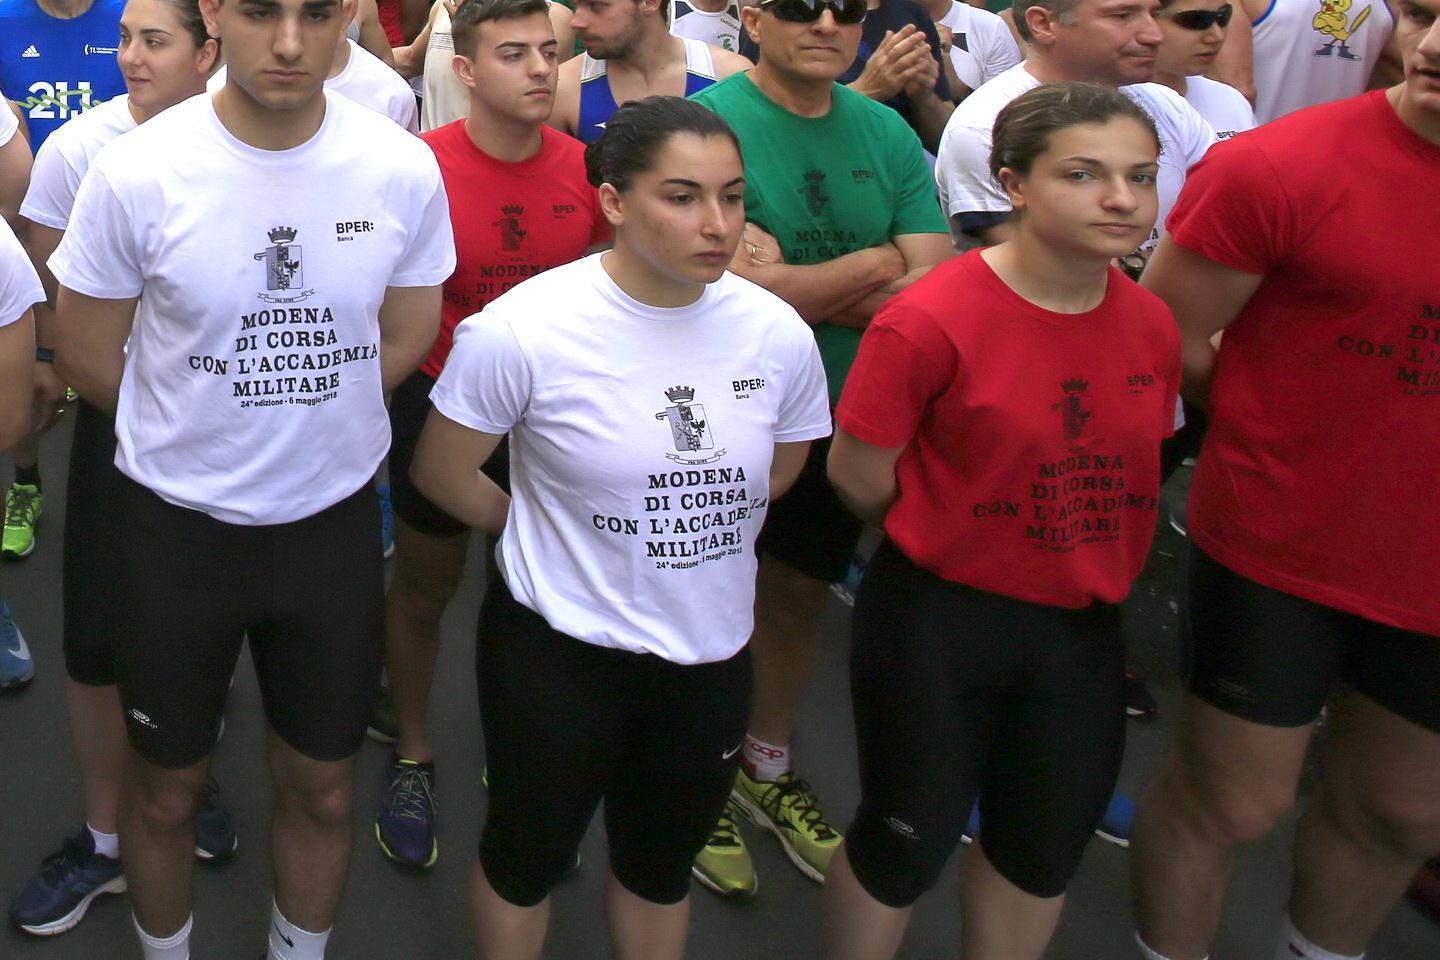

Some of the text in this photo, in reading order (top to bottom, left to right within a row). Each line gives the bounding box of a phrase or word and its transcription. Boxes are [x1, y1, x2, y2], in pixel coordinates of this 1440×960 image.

[335, 220, 375, 234] BPER:
[476, 282, 495, 295] DI
[240, 306, 334, 331] MODENA
[234, 328, 338, 353] DI CORSA
[1337, 335, 1396, 359] CON
[188, 343, 378, 375] CON L'ACCADEMIA
[232, 371, 340, 398] MILITARE
[732, 377, 765, 392] BPER:
[254, 398, 283, 407] edizione
[288, 396, 294, 404] 6
[295, 396, 321, 406] maggio
[322, 391, 338, 401] 2018
[648, 466, 746, 489] MODENA
[644, 488, 747, 512] DI CORSA
[1030, 483, 1058, 500] DI
[972, 501, 1022, 518] CON
[592, 514, 639, 535] CON
[671, 560, 699, 570] edizione
[705, 550, 727, 561] maggio
